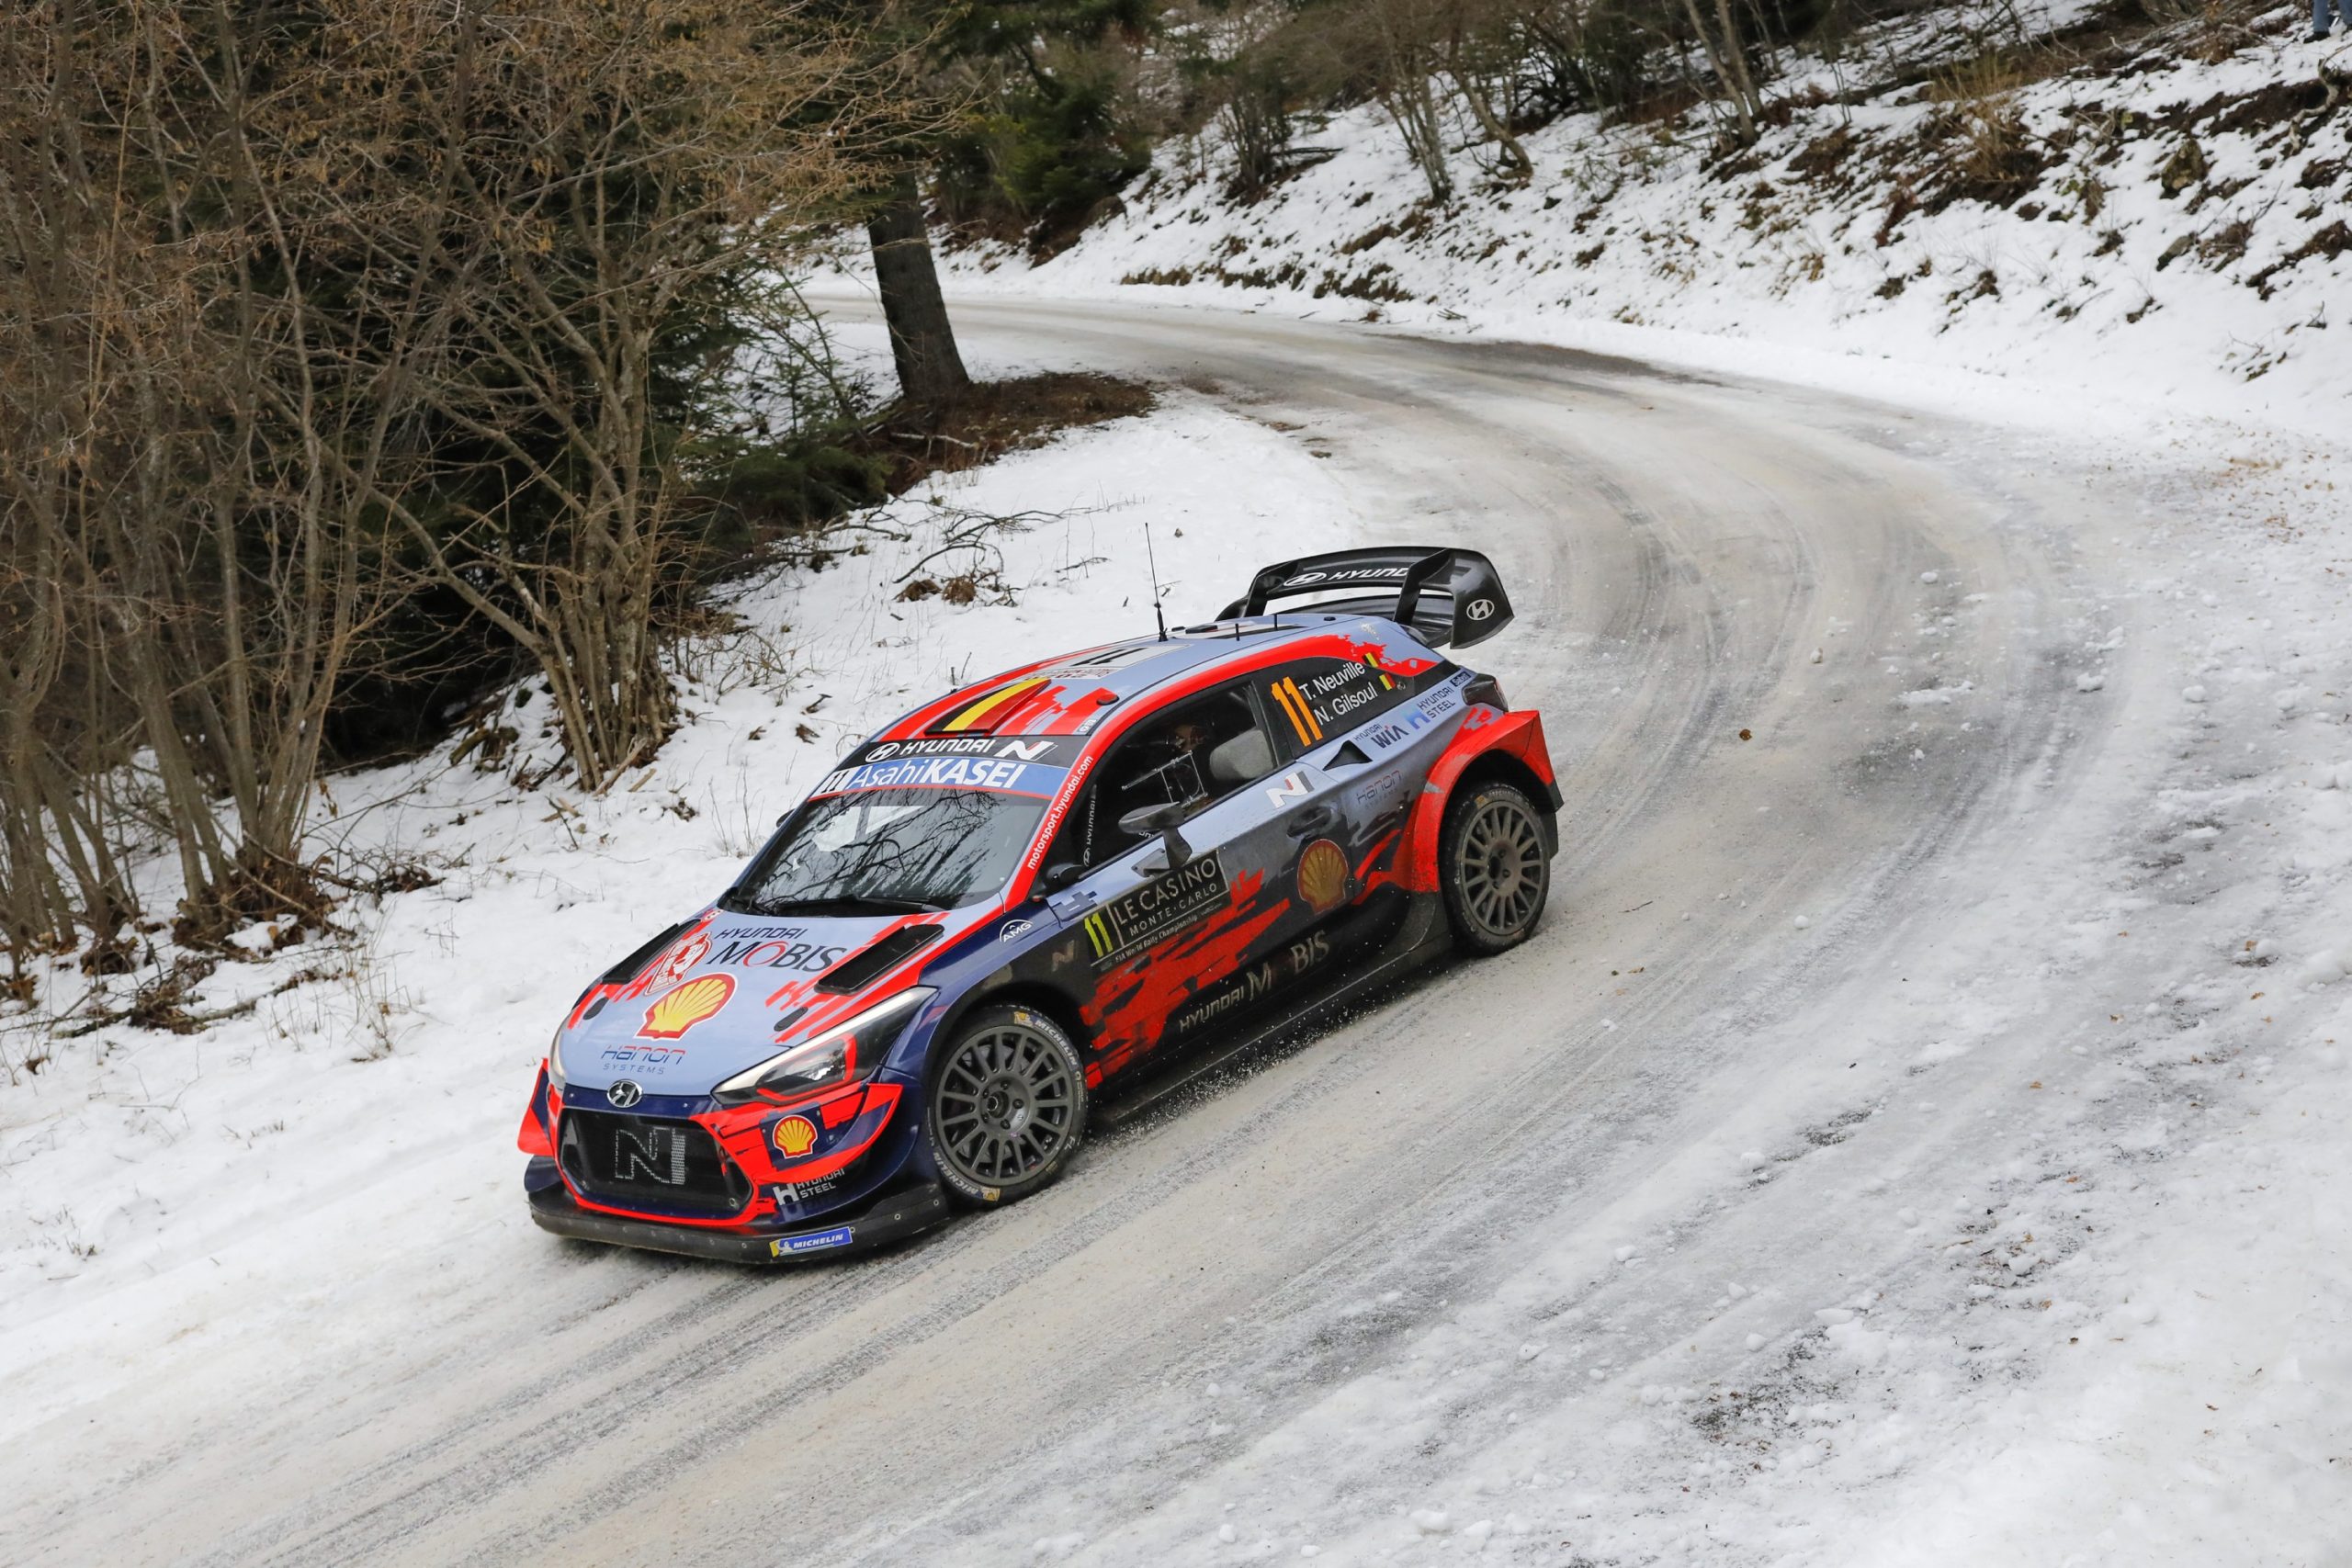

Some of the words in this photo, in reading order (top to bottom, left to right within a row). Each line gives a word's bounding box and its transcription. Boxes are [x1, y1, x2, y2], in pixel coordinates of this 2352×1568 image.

[1328, 568, 1409, 581] HYUND
[1298, 682, 1317, 701] T.
[1312, 661, 1365, 695] Neuville
[1417, 686, 1455, 710] HYUNDAI
[1272, 676, 1324, 747] 11
[1314, 705, 1334, 726] N.
[1332, 682, 1378, 716] Gilsoul
[1426, 699, 1456, 719] STEEL
[899, 739, 996, 755] HYUNDAI
[1353, 724, 1384, 742] HYUNDAI
[1027, 755, 1094, 870] motorsport.hyundai.com
[1114, 898, 1139, 926] LE
[1138, 858, 1216, 910] CASINO
[714, 927, 808, 940] HYUNDAI
[1084, 912, 1114, 958] 11
[1125, 942, 1143, 957] World
[1143, 935, 1159, 949] Rally
[1159, 912, 1198, 940] Championship
[707, 941, 847, 973] MOBIS
[1179, 985, 1245, 1033] HYUNDAI
[1246, 929, 1330, 1002] MBIS
[1035, 1019, 1078, 1066] MICHELIN
[603, 1063, 665, 1075] SYSTEMS
[799, 1181, 836, 1199] STEEL
[933, 1152, 978, 1195] MICHELIN
[793, 1234, 844, 1249] MICHELIN
